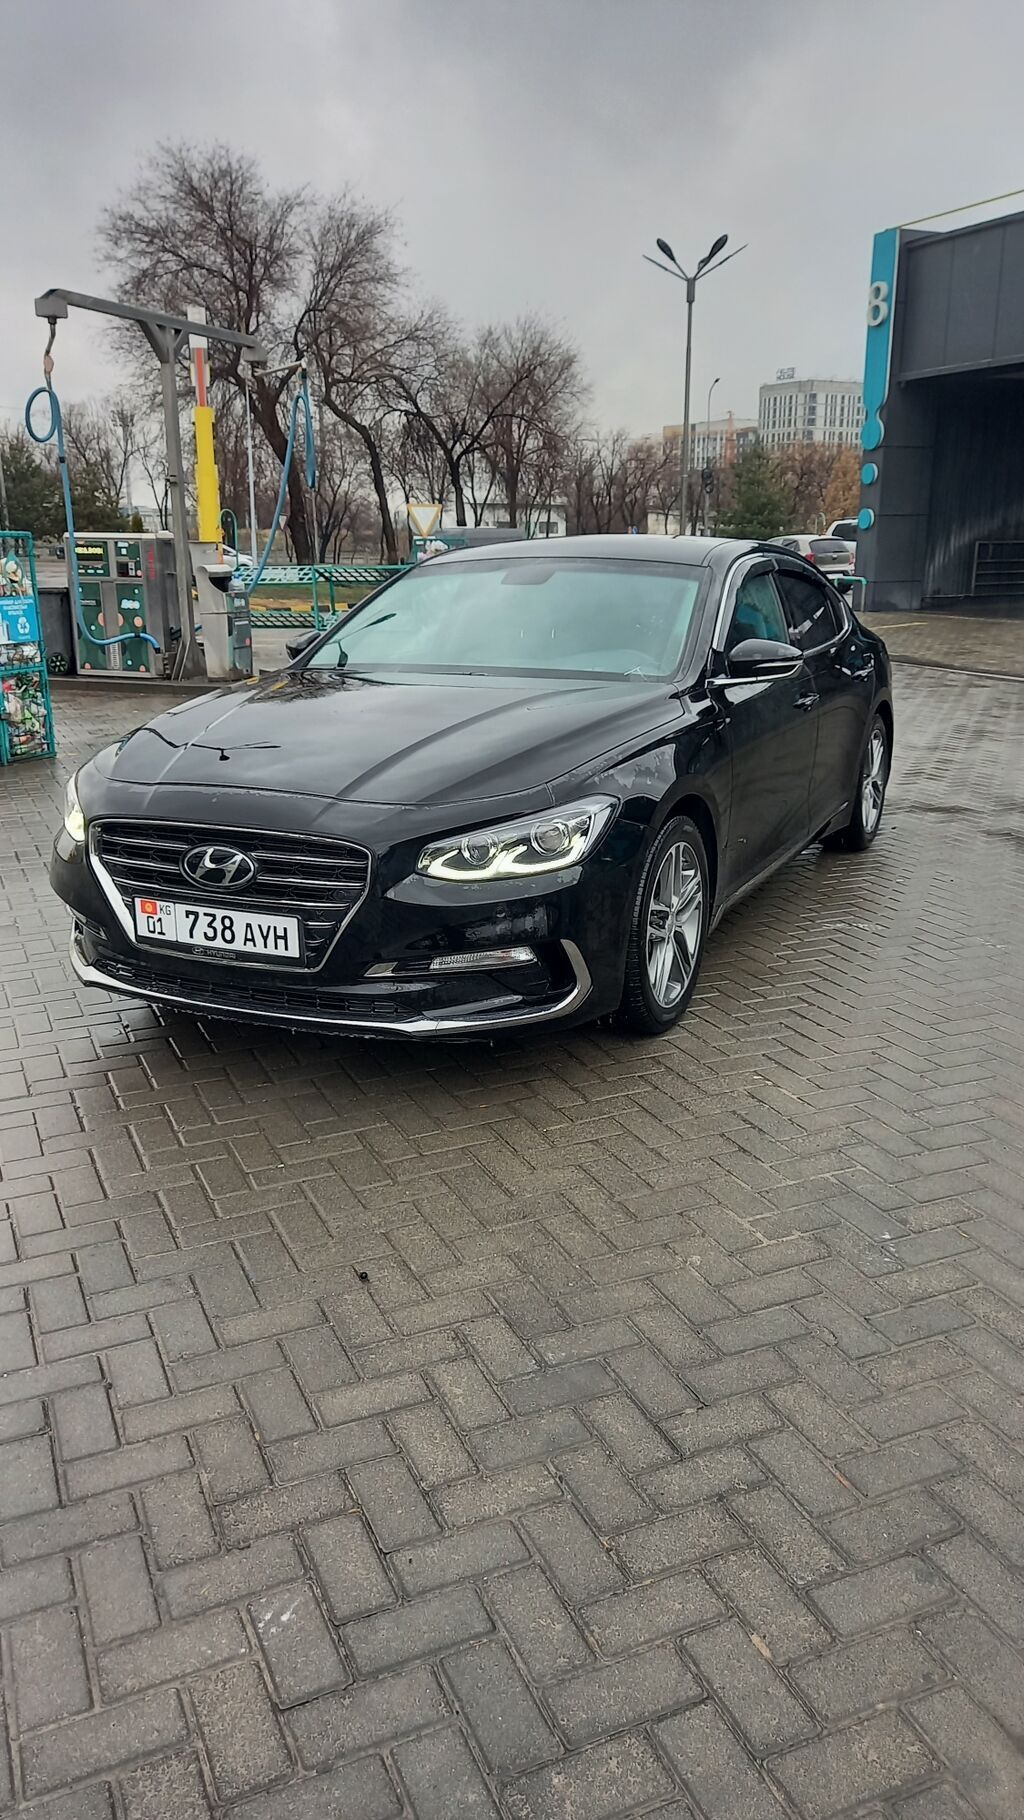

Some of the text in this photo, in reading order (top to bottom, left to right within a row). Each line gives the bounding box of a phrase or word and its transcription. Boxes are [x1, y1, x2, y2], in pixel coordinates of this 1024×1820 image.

[866, 281, 889, 327] 8
[159, 905, 171, 915] KG
[147, 910, 289, 951] 01 738 AYH
[205, 949, 237, 960] HYUNDAI
